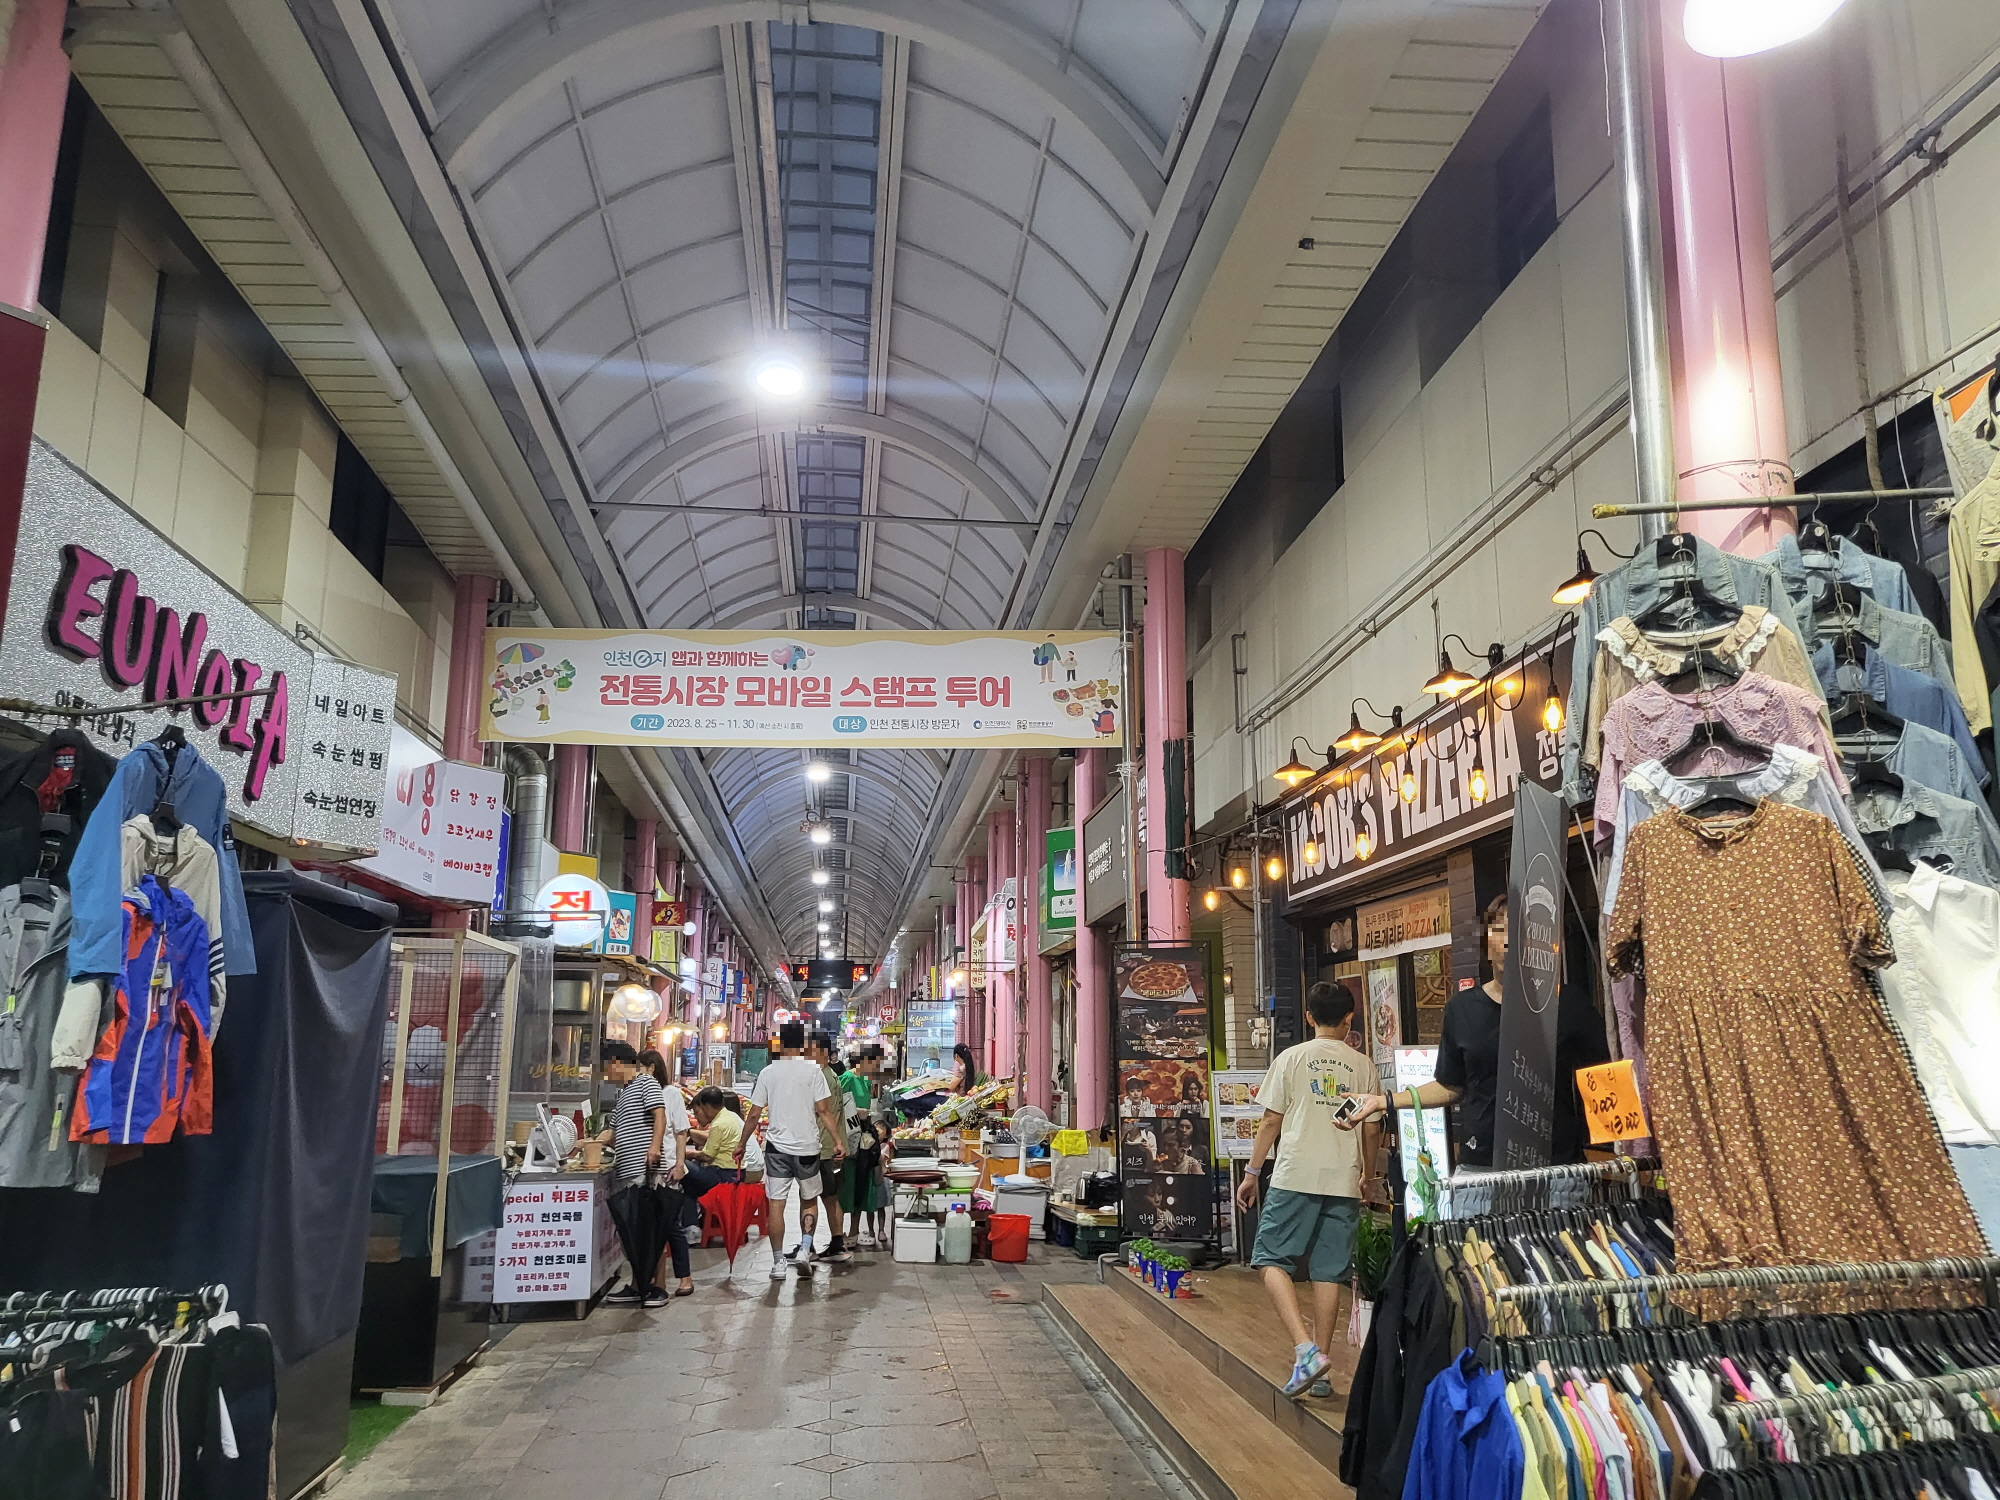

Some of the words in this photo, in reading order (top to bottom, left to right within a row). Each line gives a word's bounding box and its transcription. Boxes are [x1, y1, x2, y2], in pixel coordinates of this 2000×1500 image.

[671, 651, 703, 667] 앱과
[706, 651, 769, 667] 함께하는
[49, 545, 288, 801] EUNOIA
[599, 674, 729, 708] 전통시장
[733, 675, 832, 708] 모바일
[839, 675, 938, 708] 스탬프
[945, 675, 1012, 708] 투어
[637, 717, 660, 729] 기간
[667, 719, 691, 729] 2023.
[705, 719, 717, 729] 25
[728, 719, 741, 729] 11.
[742, 719, 755, 729] 30
[838, 718, 861, 730] 대상
[870, 718, 889, 730] 인천
[891, 718, 930, 730] 전통시장
[931, 718, 961, 730] 방문자
[1291, 769, 1378, 885] JACOB'S
[1380, 692, 1522, 846] PIZZERIA
[303, 789, 377, 819] 속눈썹연장
[450, 788, 497, 810] 닭강정
[446, 822, 494, 842] 코코넛새우
[442, 858, 493, 878] 베이비크랩
[549, 890, 592, 921] 전
[1405, 917, 1432, 941] PIZZA
[1343, 1063, 1354, 1073] TRIP
[1126, 1156, 1144, 1167] 치즈
[506, 1192, 544, 1206] pecial
[507, 1213, 534, 1224] 5가지
[1138, 1213, 1154, 1225] 인성
[1175, 1213, 1197, 1227] 있어?
[499, 1256, 527, 1267] 5가지
